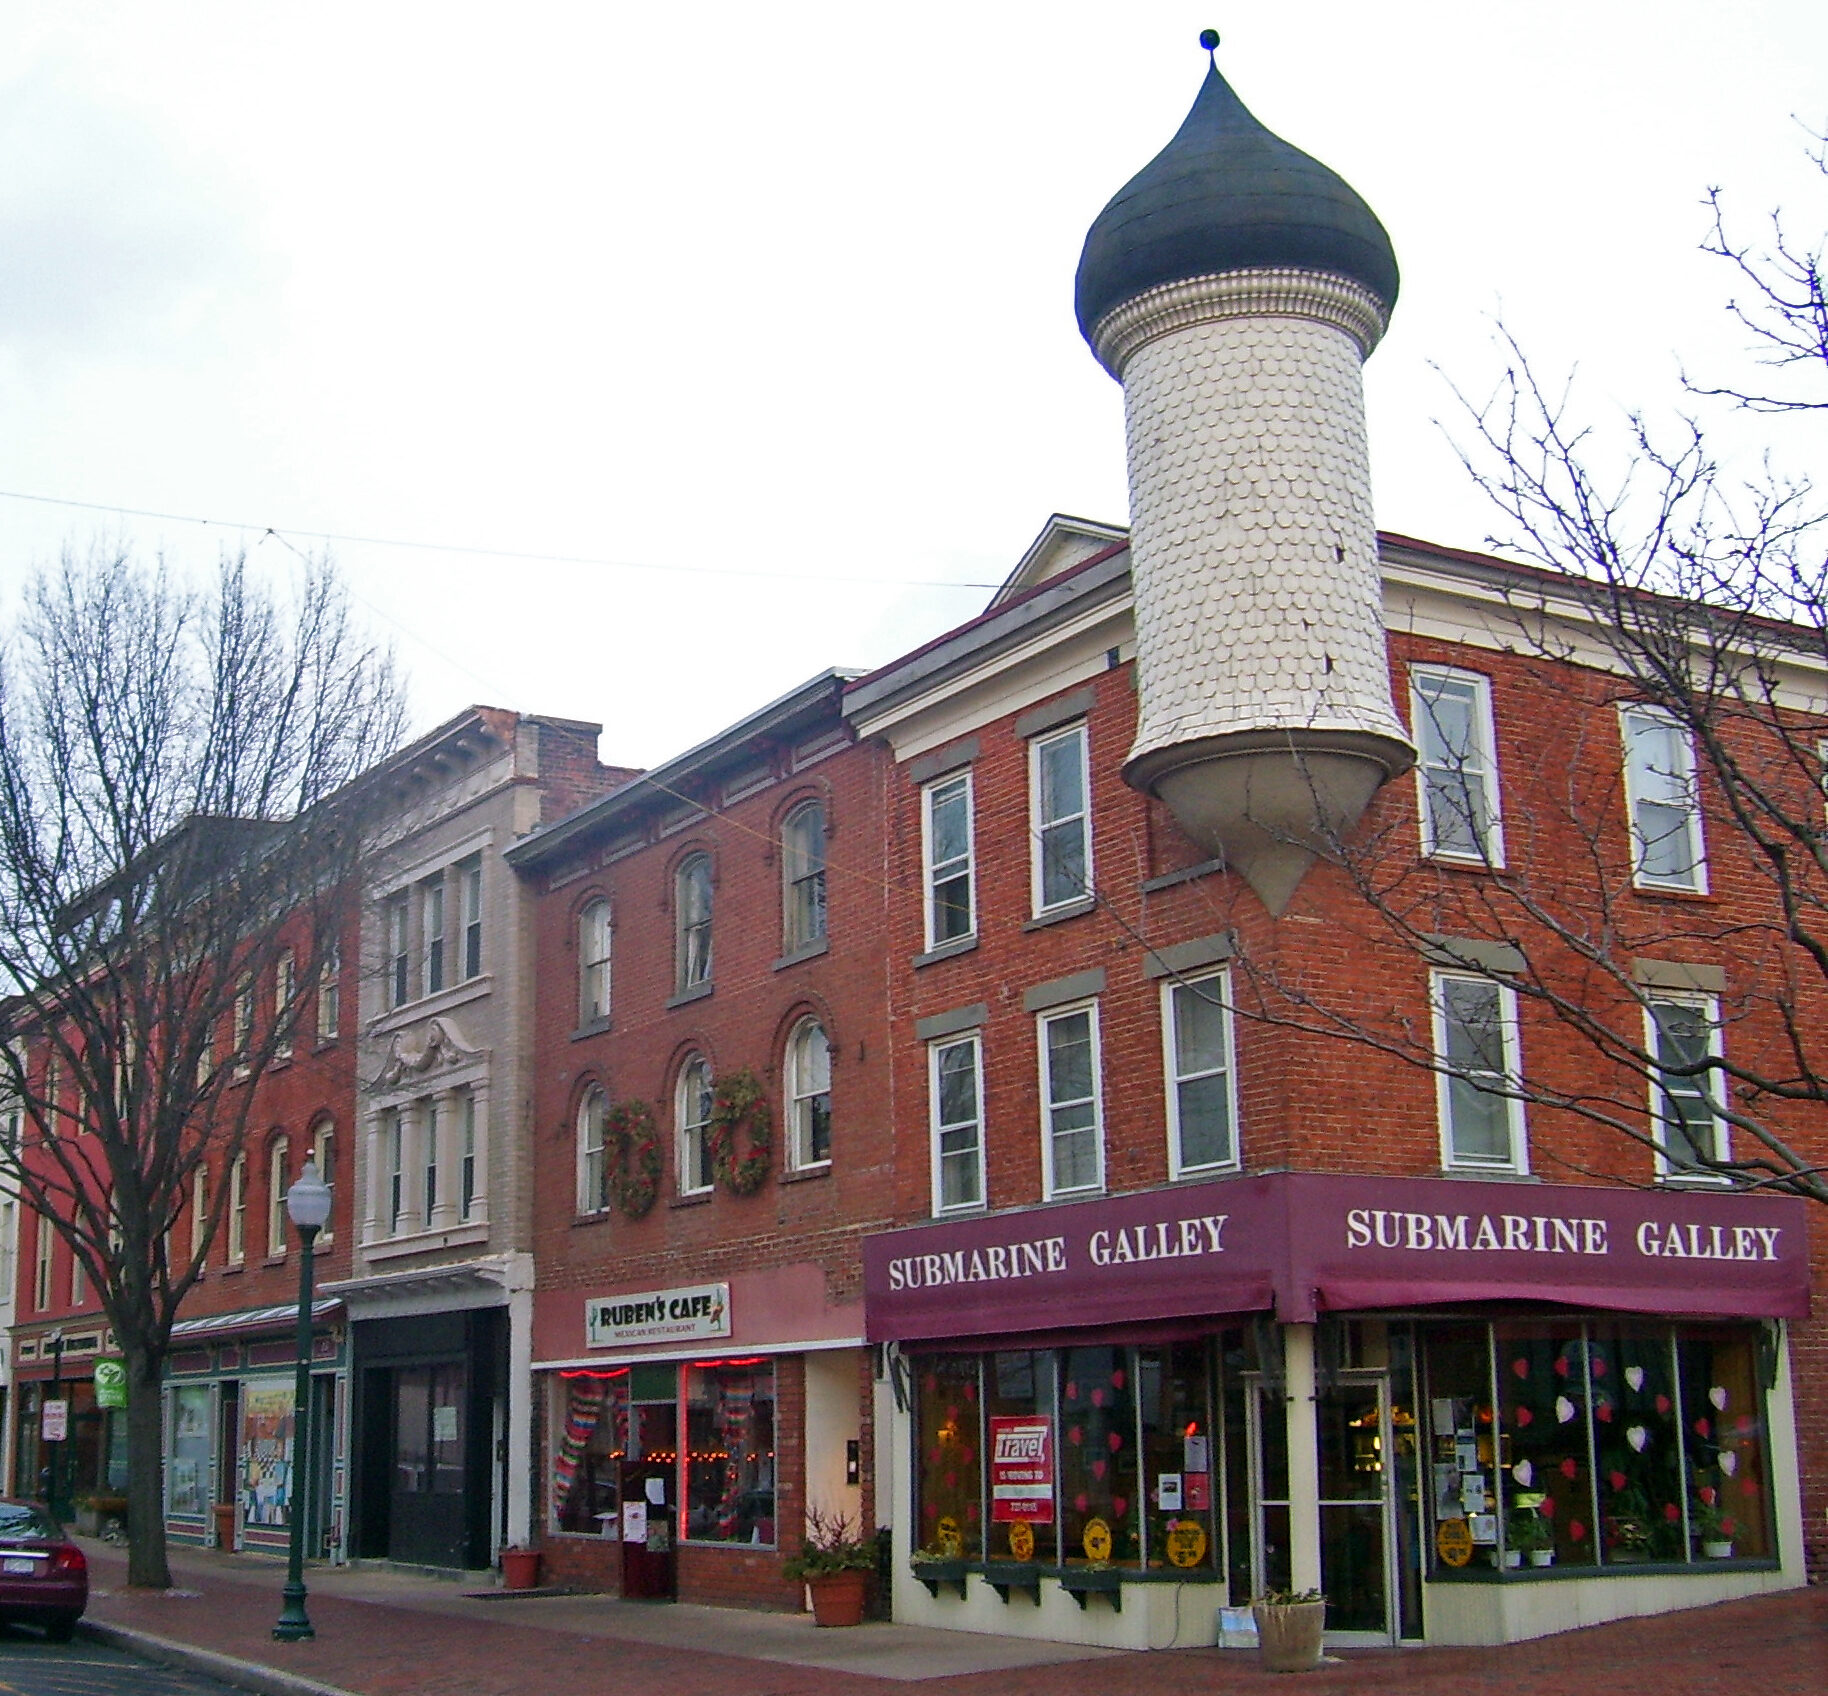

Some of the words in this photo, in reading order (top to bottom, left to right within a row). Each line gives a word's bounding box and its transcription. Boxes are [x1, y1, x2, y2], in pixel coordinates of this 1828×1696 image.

[1347, 1209, 1608, 1254] SUBMARINE
[1636, 1221, 1781, 1261] GALLEY
[889, 1236, 1067, 1291] SUBMARINE
[1089, 1215, 1229, 1267] GALLEY
[600, 1295, 666, 1327] RUBEN'S
[669, 1295, 712, 1320] CAFE
[614, 1328, 646, 1338] MEXICAN
[648, 1323, 696, 1335] RESTAURANT
[995, 1432, 1045, 1458] Travel
